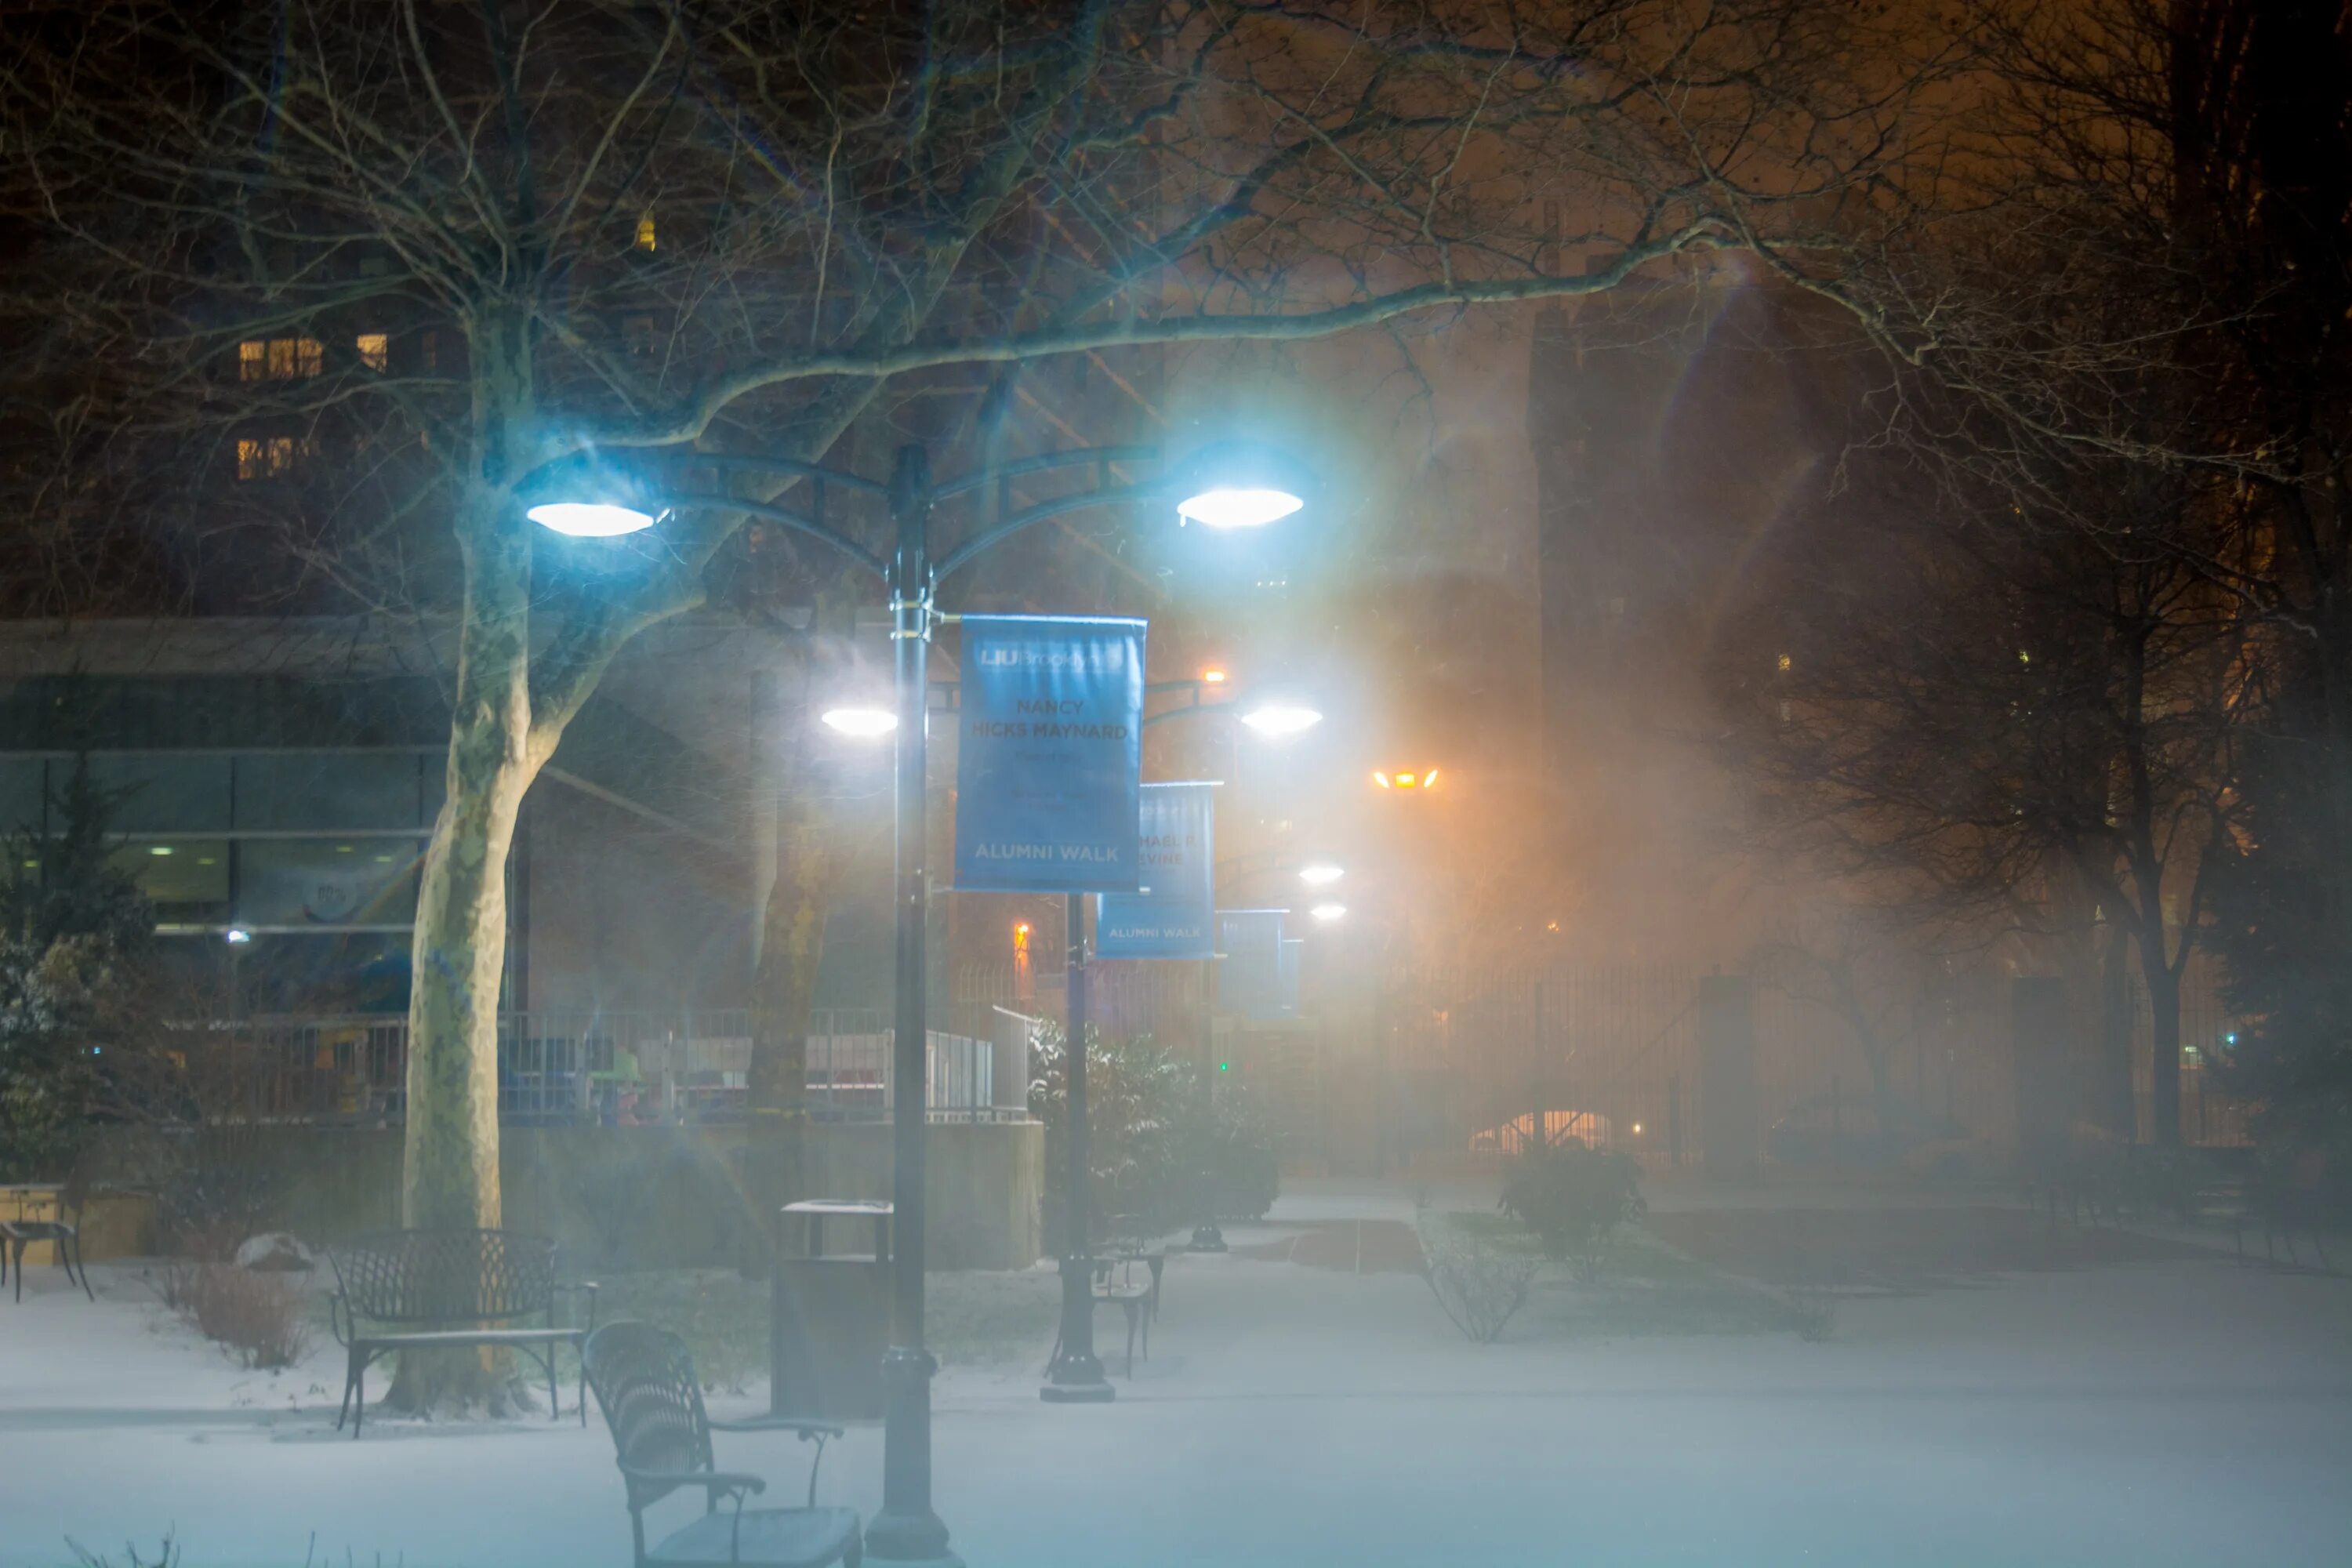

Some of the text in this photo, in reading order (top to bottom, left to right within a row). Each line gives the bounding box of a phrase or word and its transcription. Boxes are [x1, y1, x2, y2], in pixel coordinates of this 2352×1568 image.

[1017, 699, 1083, 715] NANCY
[973, 722, 1127, 740] HICKS MAYNARD
[975, 843, 1119, 862] ALUMNI WALK
[1109, 928, 1200, 938] ALUMNI WALK
